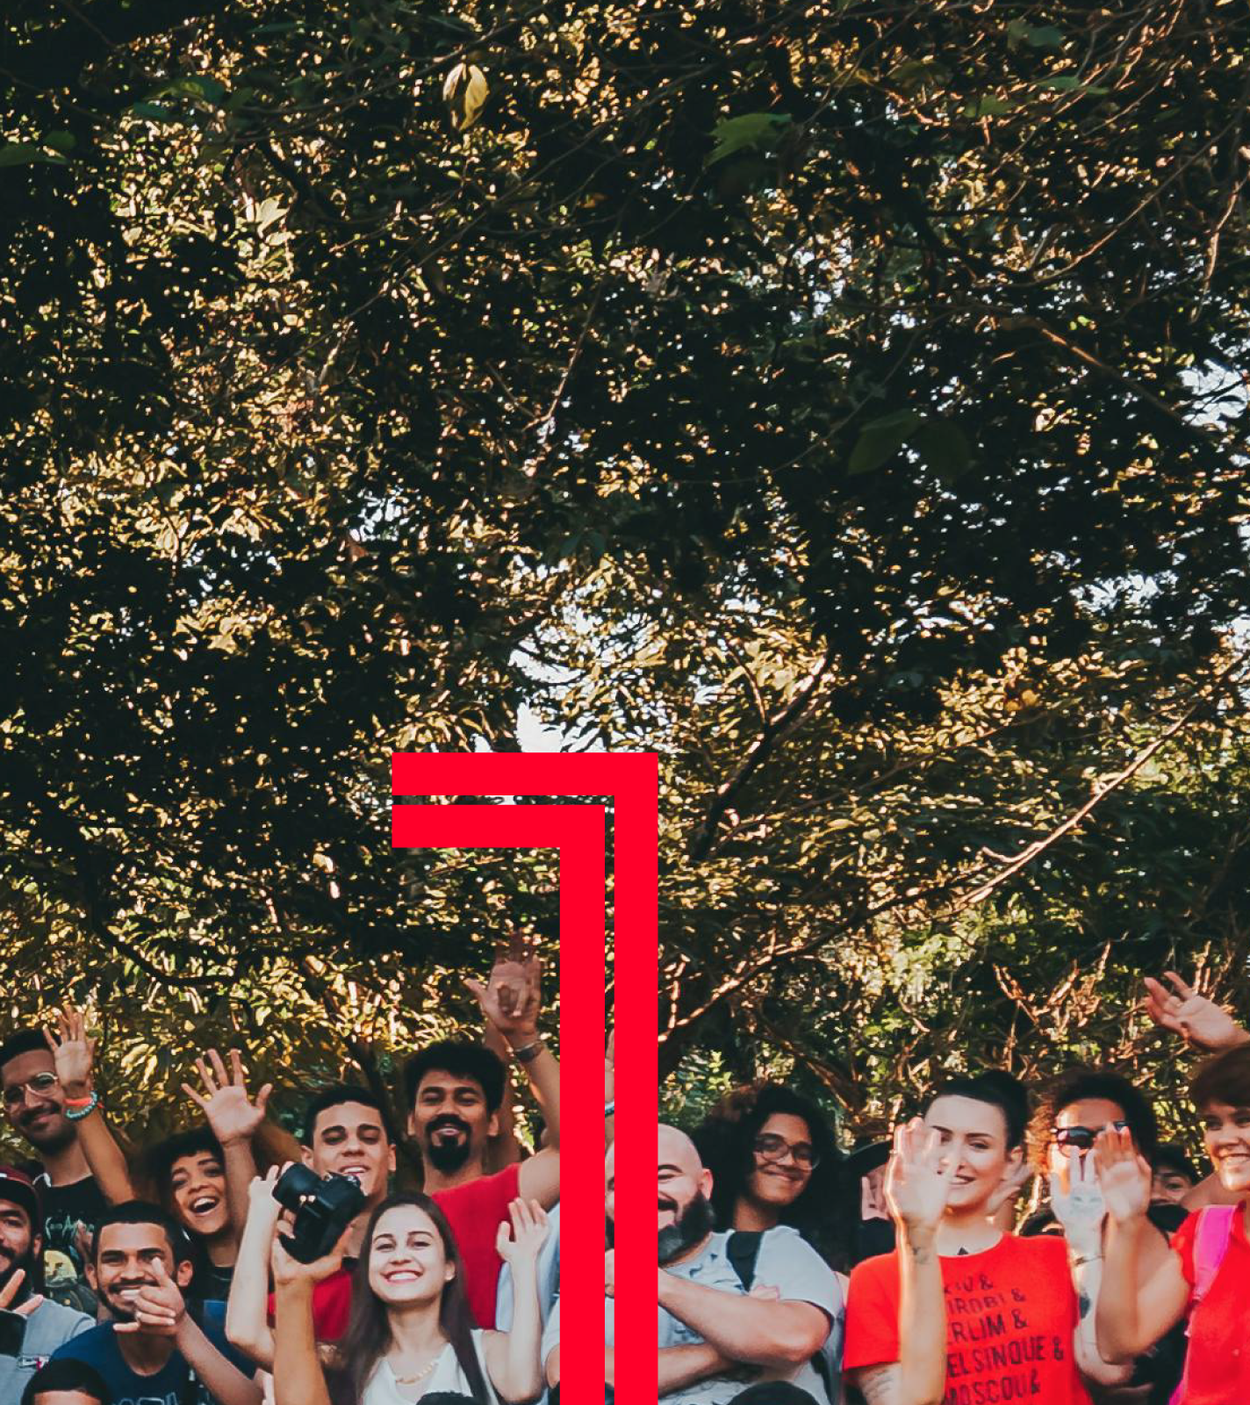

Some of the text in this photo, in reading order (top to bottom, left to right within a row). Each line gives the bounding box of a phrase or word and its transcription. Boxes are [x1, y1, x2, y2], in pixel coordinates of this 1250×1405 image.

[947, 1293, 1005, 1315] IROBI
[948, 1308, 1028, 1342] RLIM &
[946, 1335, 1047, 1378] ELSINQUE
